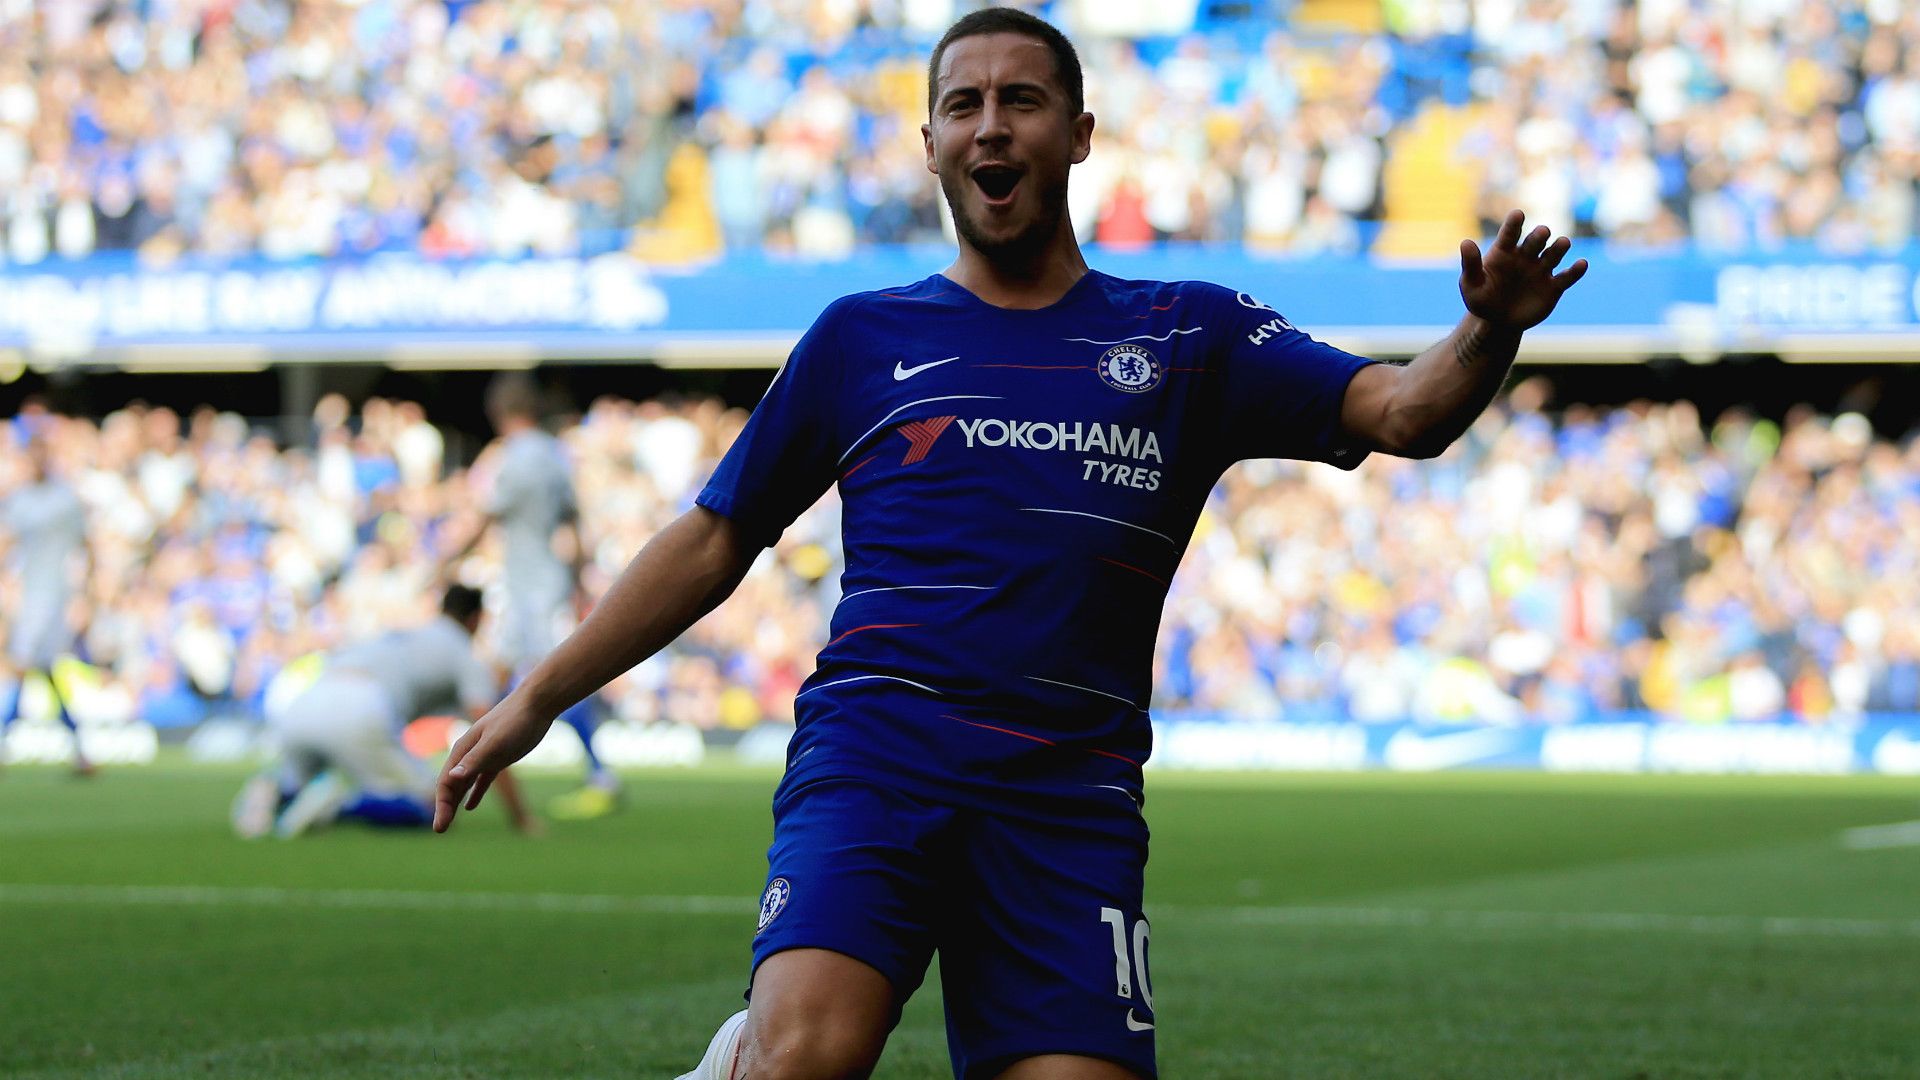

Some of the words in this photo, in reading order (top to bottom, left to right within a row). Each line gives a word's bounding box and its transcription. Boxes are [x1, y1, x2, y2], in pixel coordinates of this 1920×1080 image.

[1108, 346, 1148, 358] CHELSEA
[956, 418, 1163, 464] YOKOHAMA
[1083, 459, 1162, 491] TYRES
[1101, 906, 1154, 1014] 10
